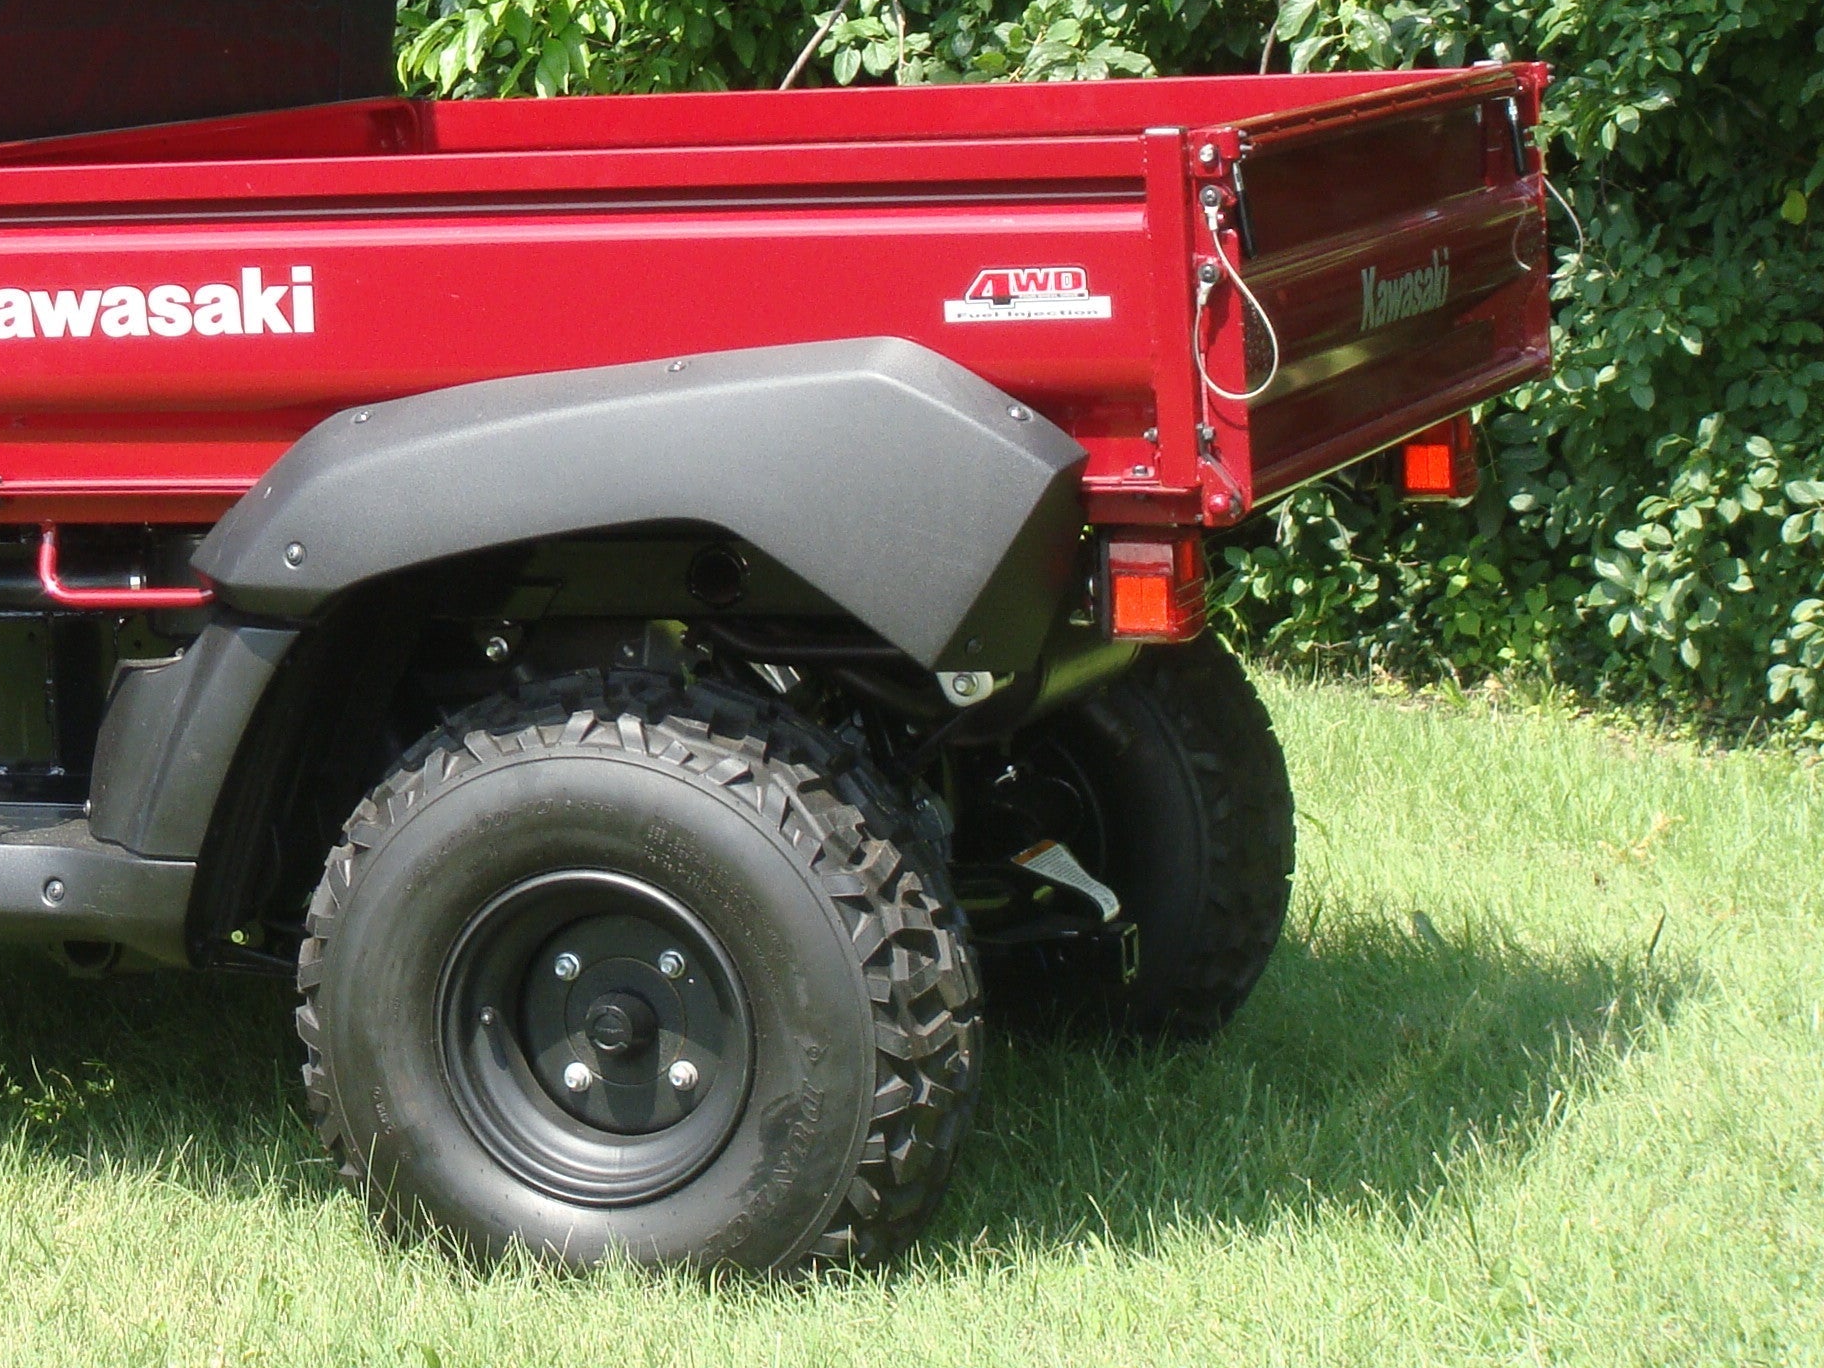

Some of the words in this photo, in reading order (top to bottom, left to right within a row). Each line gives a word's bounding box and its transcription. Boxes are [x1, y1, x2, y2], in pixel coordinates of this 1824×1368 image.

[968, 269, 1086, 306] 4WD
[1360, 246, 1450, 332] Kawasaki
[956, 311, 999, 319] Fuel
[1007, 308, 1099, 319] Injection
